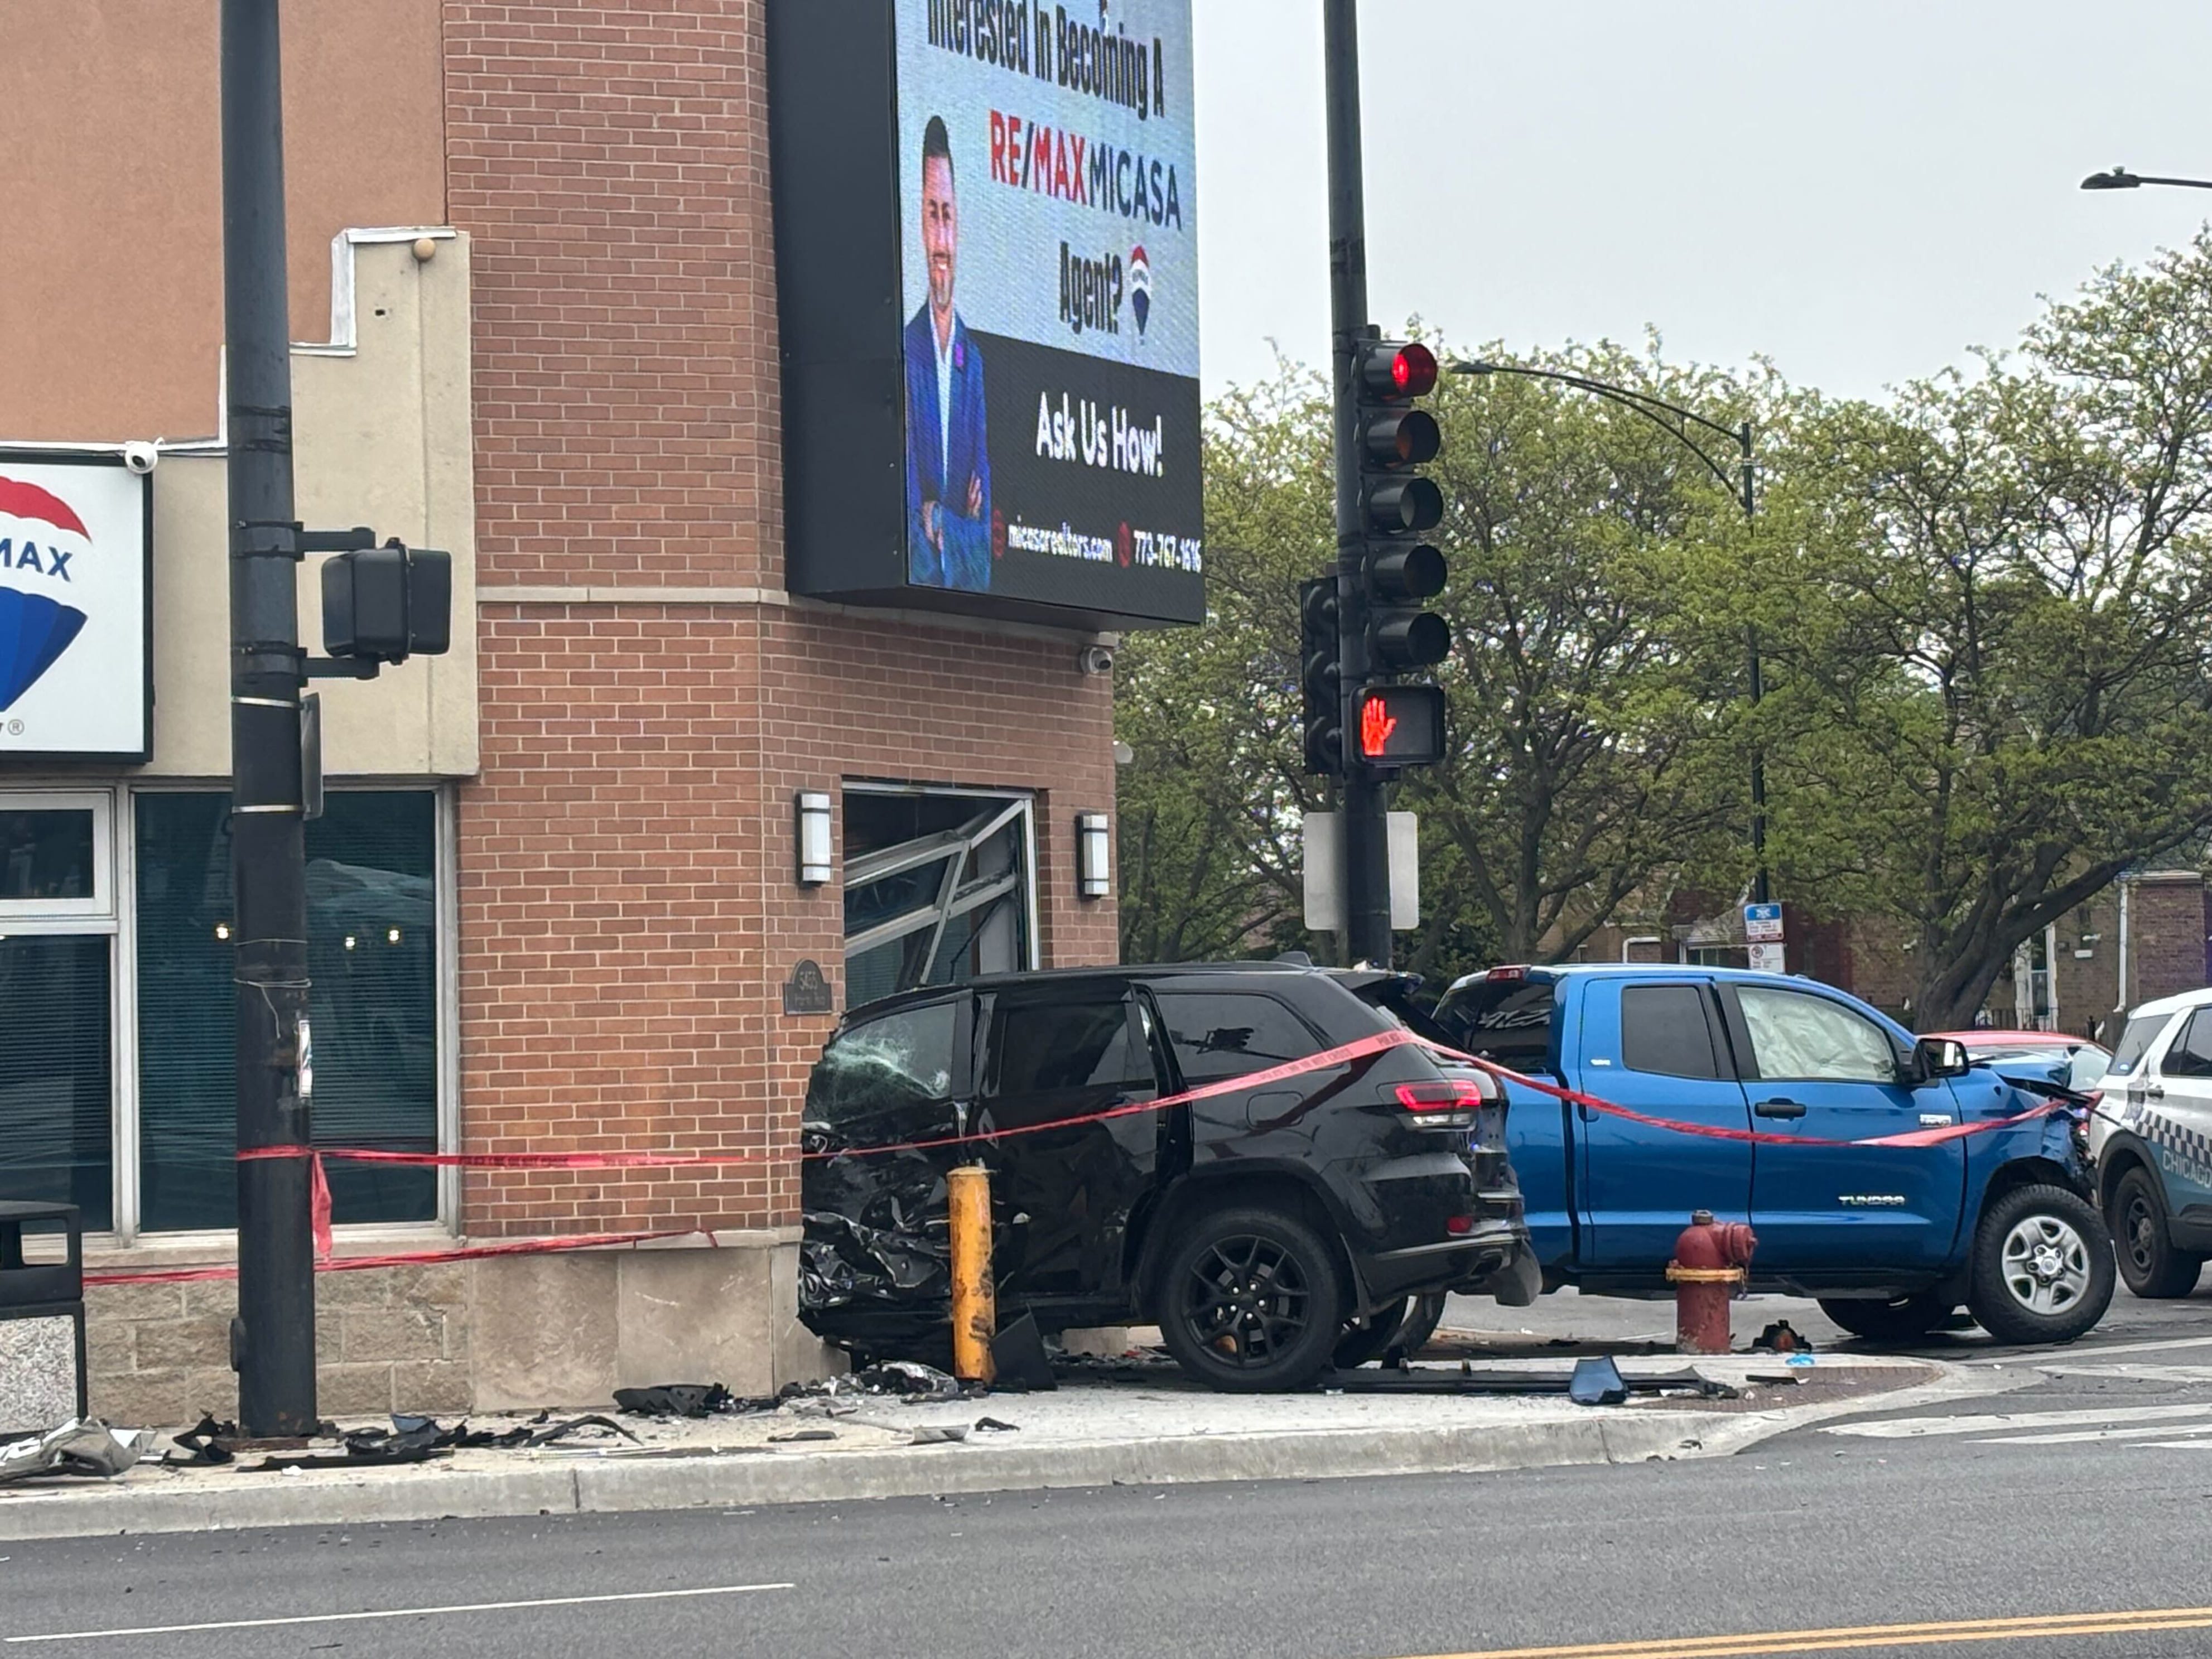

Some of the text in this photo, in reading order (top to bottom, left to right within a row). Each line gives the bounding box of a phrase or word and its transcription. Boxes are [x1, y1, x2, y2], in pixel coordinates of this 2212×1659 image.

[1034, 0, 1052, 82] In
[1056, 4, 1148, 121] Becoming
[1153, 37, 1165, 118] A
[1060, 241, 1122, 335] Agent?
[1037, 391, 1163, 478] Ask Us How!
[2162, 1150, 2212, 1189] CHICAGO
